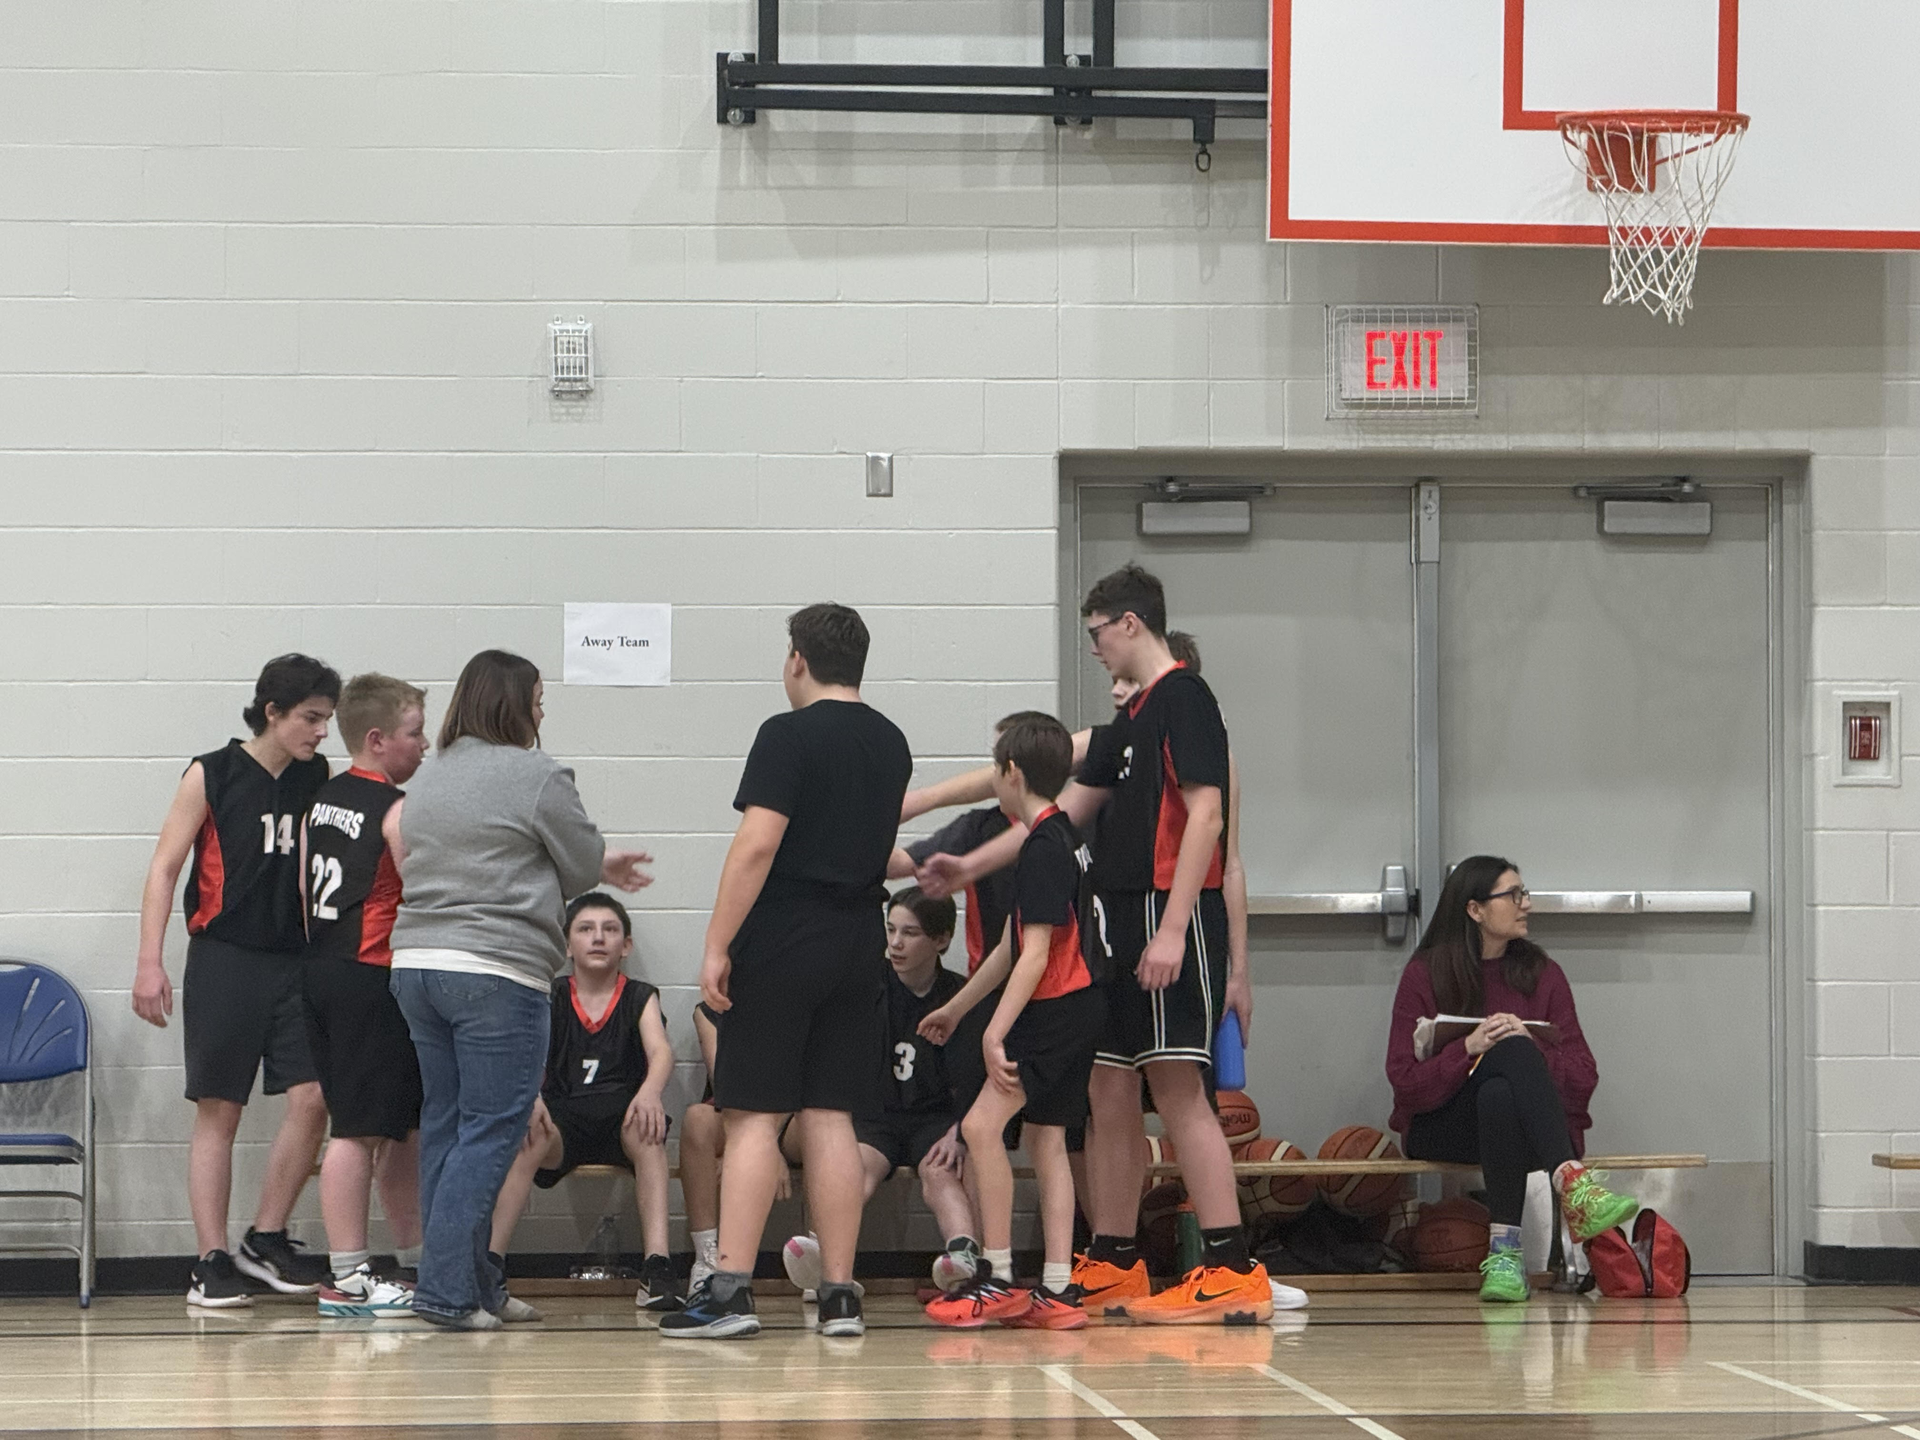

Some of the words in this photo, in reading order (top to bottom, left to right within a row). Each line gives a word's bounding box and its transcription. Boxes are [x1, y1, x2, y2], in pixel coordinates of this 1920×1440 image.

[1366, 331, 1443, 390] EXIT
[581, 635, 614, 651] Away
[617, 635, 649, 647] Team
[261, 813, 294, 855] 14
[309, 803, 365, 839] PANTHERS
[312, 853, 342, 919] 22
[582, 1059, 599, 1084] 7
[893, 1041, 916, 1081] 3
